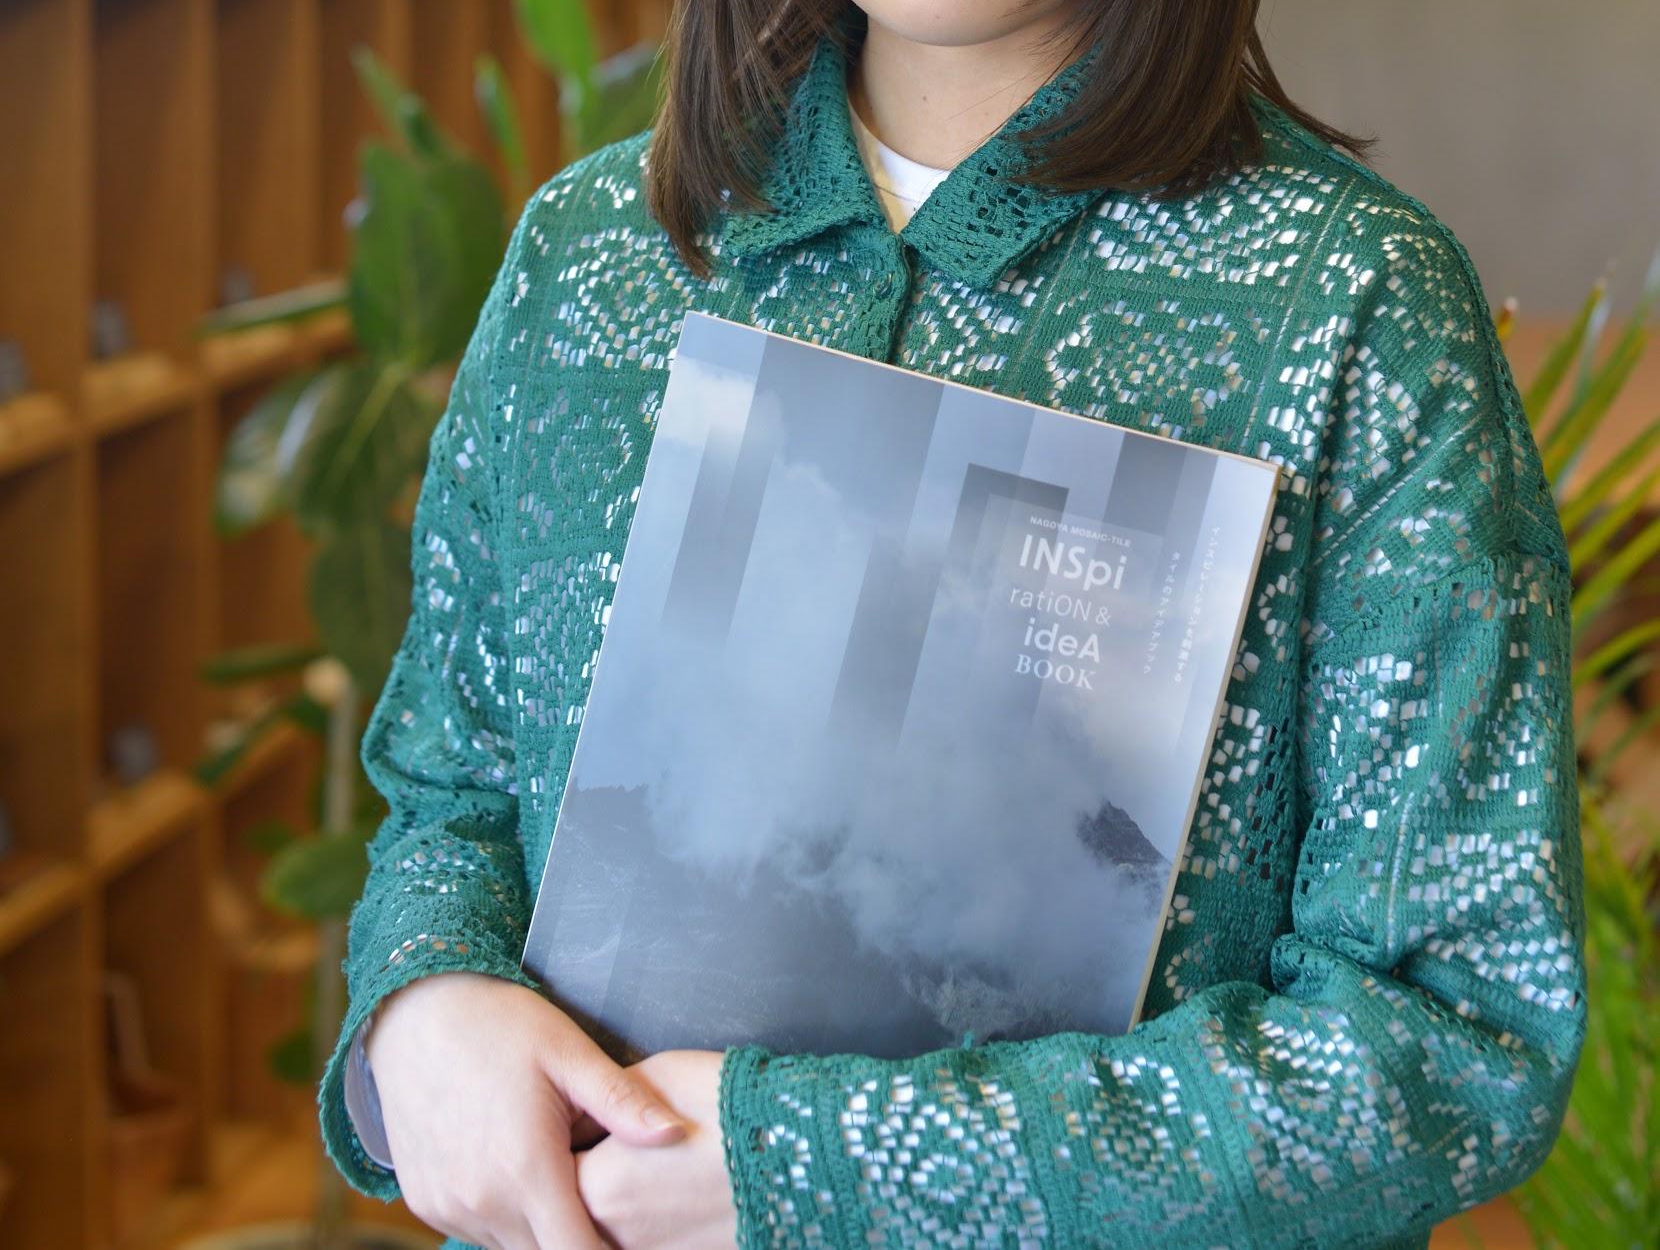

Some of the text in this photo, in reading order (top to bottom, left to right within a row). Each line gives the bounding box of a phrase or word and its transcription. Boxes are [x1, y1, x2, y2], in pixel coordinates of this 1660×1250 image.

[1030, 516, 1131, 548] NAGOYA MOSAIC-TILE
[1019, 534, 1127, 591] INSpi
[1010, 588, 1111, 627] ratiON &
[1024, 617, 1099, 663] ideA
[1015, 653, 1096, 690] BOOK
